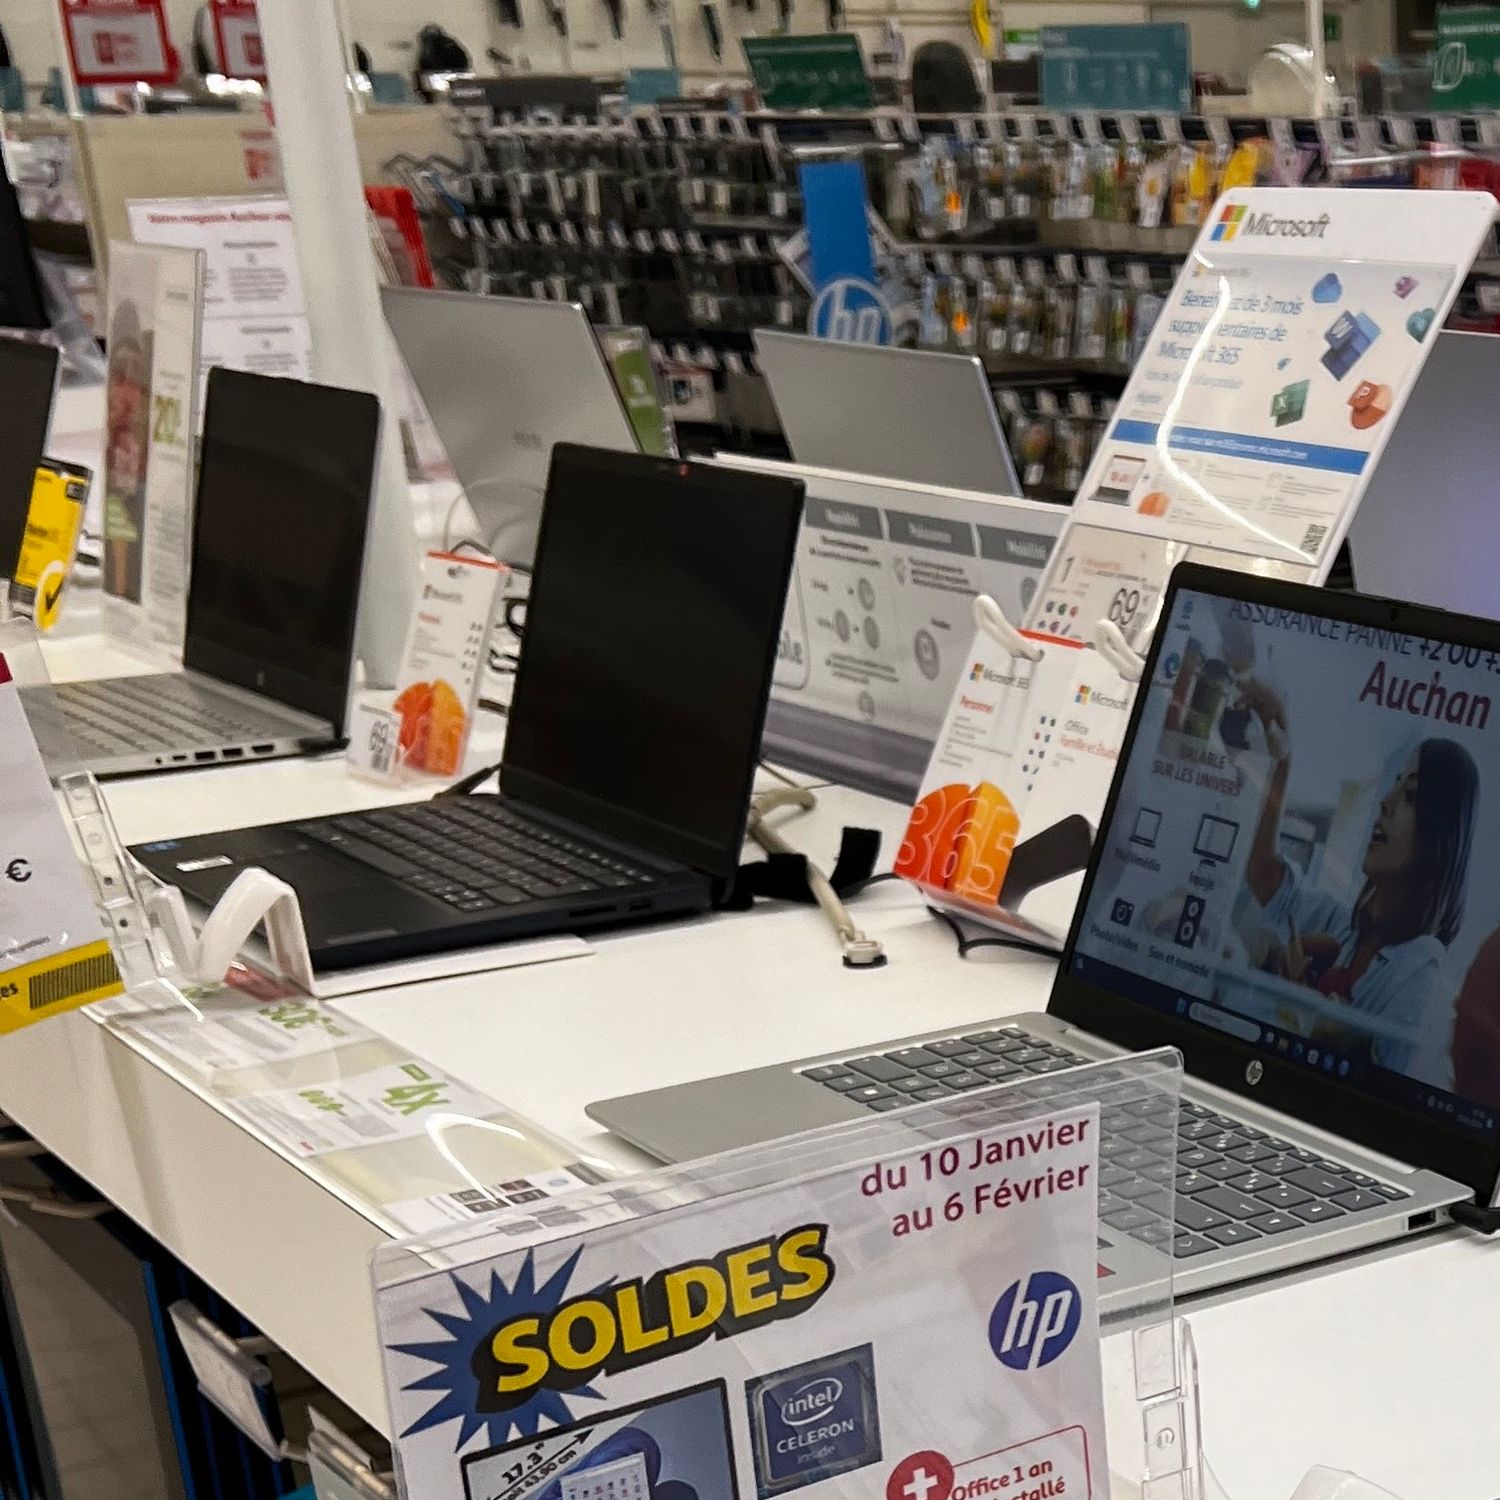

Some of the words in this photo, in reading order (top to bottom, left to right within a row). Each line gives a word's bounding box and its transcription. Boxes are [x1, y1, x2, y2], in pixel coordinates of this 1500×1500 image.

[1359, 660, 1492, 729] Auchan
[5, 858, 32, 883] €
[861, 1162, 907, 1198] du
[920, 1146, 960, 1181] 10
[968, 1118, 1090, 1170] Janvier
[892, 1206, 933, 1237] au
[944, 1191, 965, 1222] 6
[974, 1164, 1090, 1214] Février
[491, 1229, 831, 1394] SOLDES
[776, 1418, 856, 1455] CELERON
[1013, 1466, 1025, 1484] 1
[1028, 1459, 1053, 1479] an
